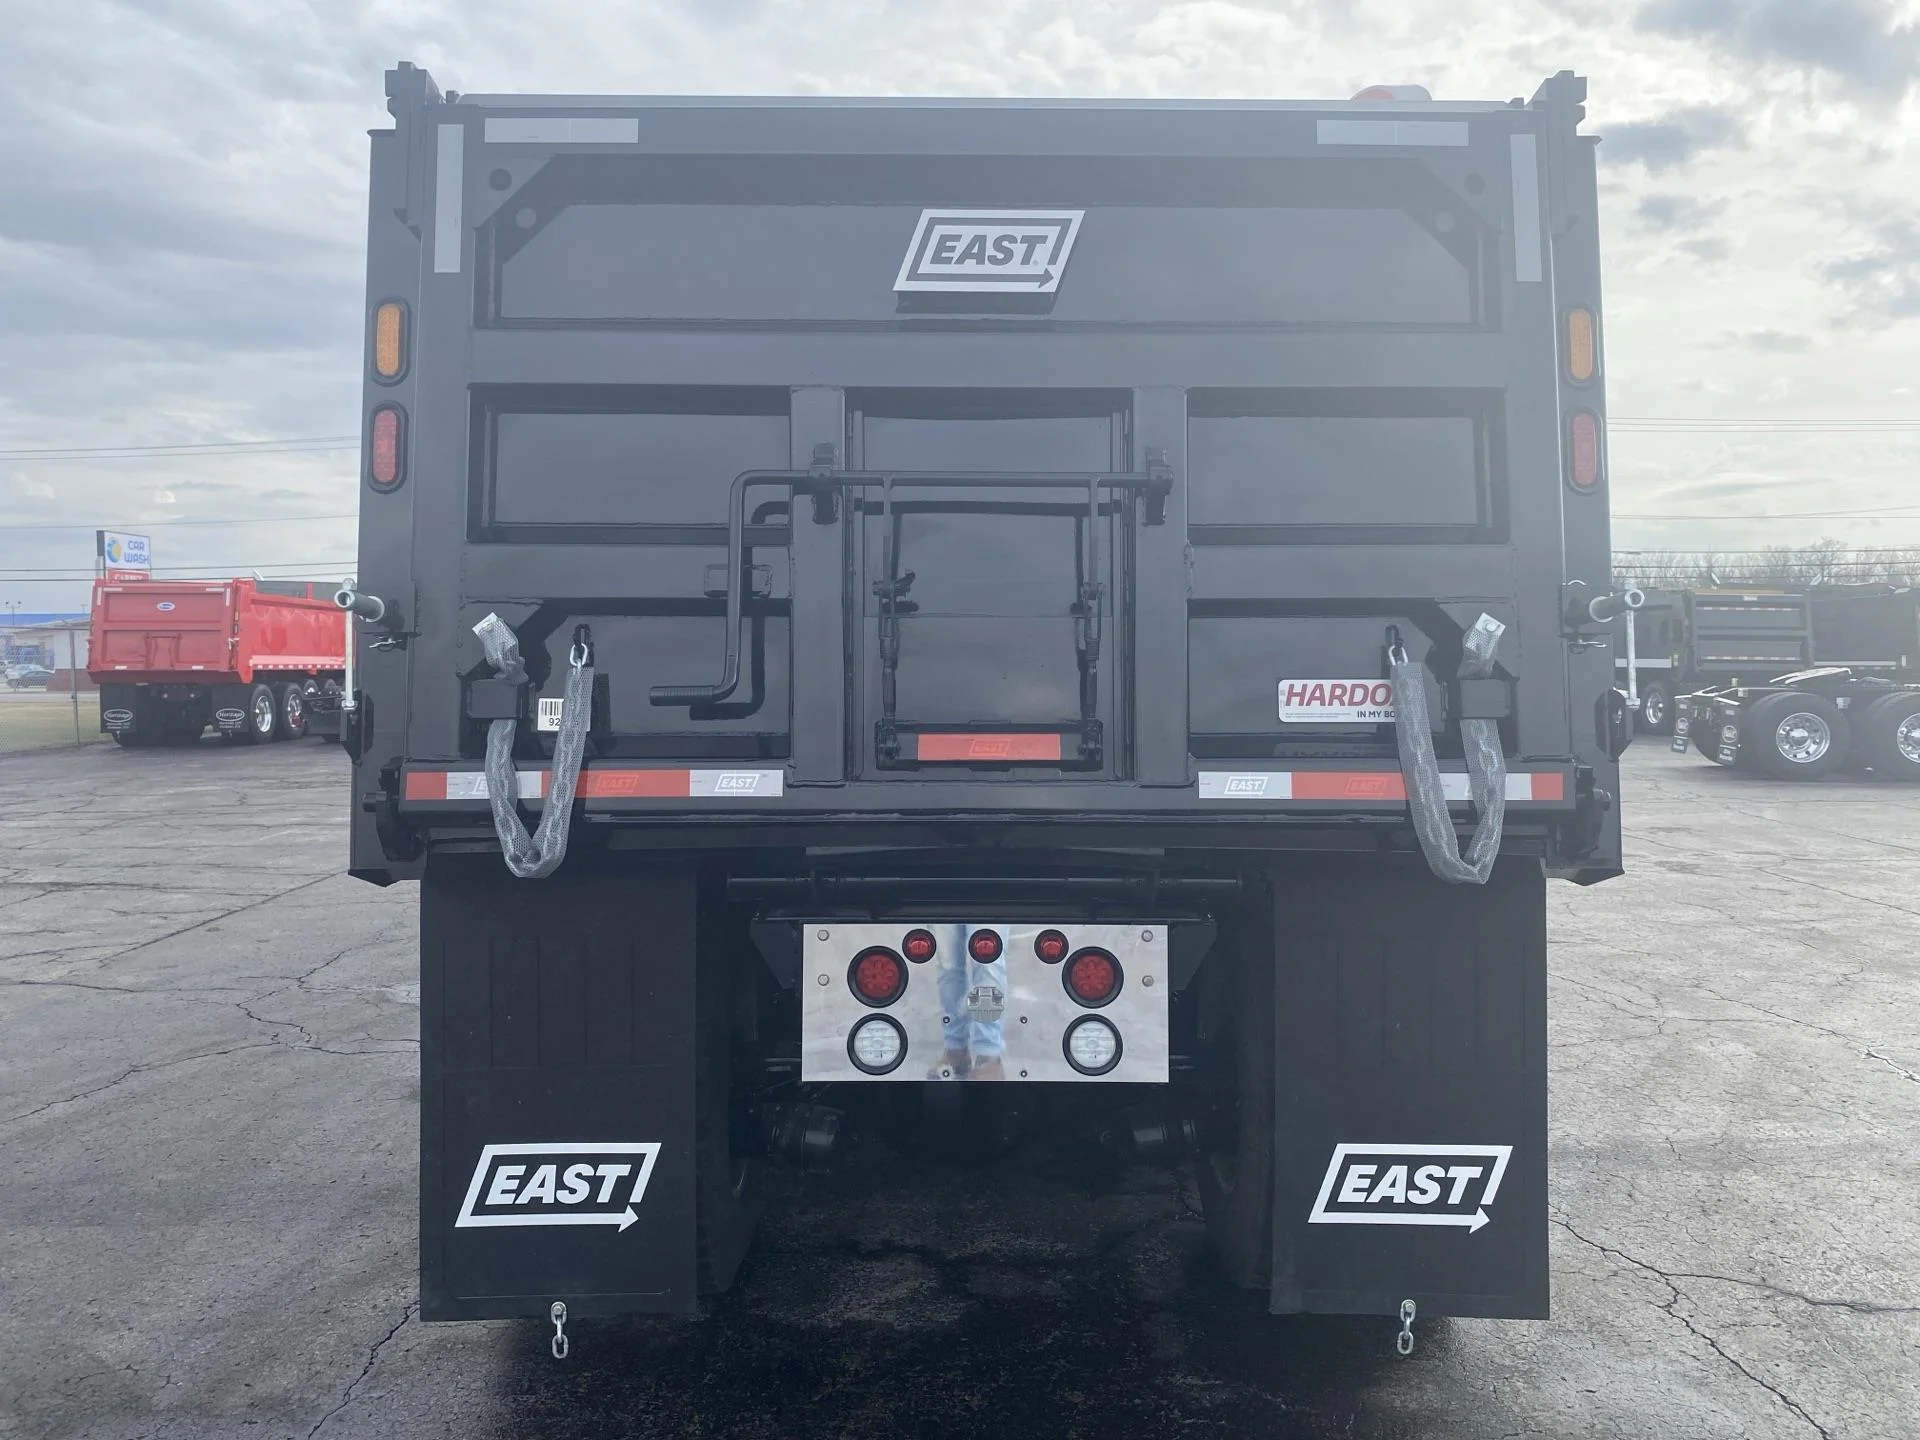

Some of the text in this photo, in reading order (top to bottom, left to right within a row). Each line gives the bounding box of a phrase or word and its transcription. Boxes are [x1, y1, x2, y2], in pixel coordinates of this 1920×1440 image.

[929, 233, 1049, 266] EAST
[127, 540, 145, 551] CAR
[124, 552, 151, 564] WASH
[1285, 683, 1394, 706] HARDO
[601, 776, 635, 789] EAST
[720, 777, 754, 788] EAST
[1229, 780, 1262, 791] EAST
[1350, 780, 1383, 791] EAST
[485, 1163, 632, 1205] EAST
[1336, 1164, 1484, 1205] EAST
